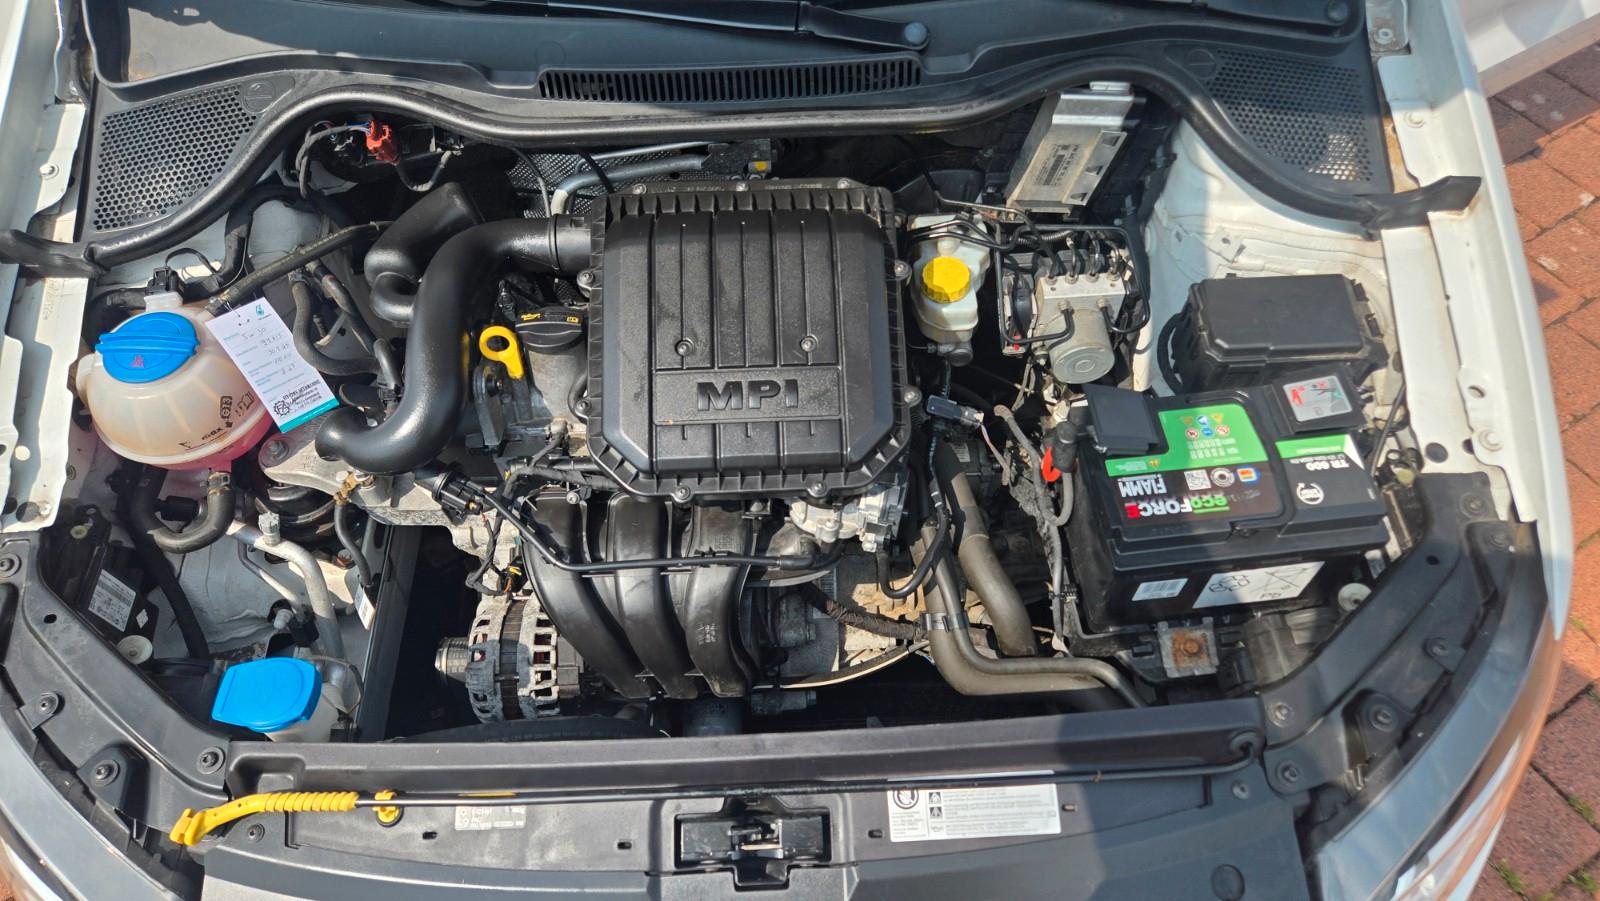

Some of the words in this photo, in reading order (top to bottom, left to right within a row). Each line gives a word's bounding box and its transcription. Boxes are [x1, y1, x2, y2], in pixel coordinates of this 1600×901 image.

[697, 379, 799, 411] MPI
[1330, 459, 1350, 469] TR
[1118, 477, 1168, 498] FIAMM
